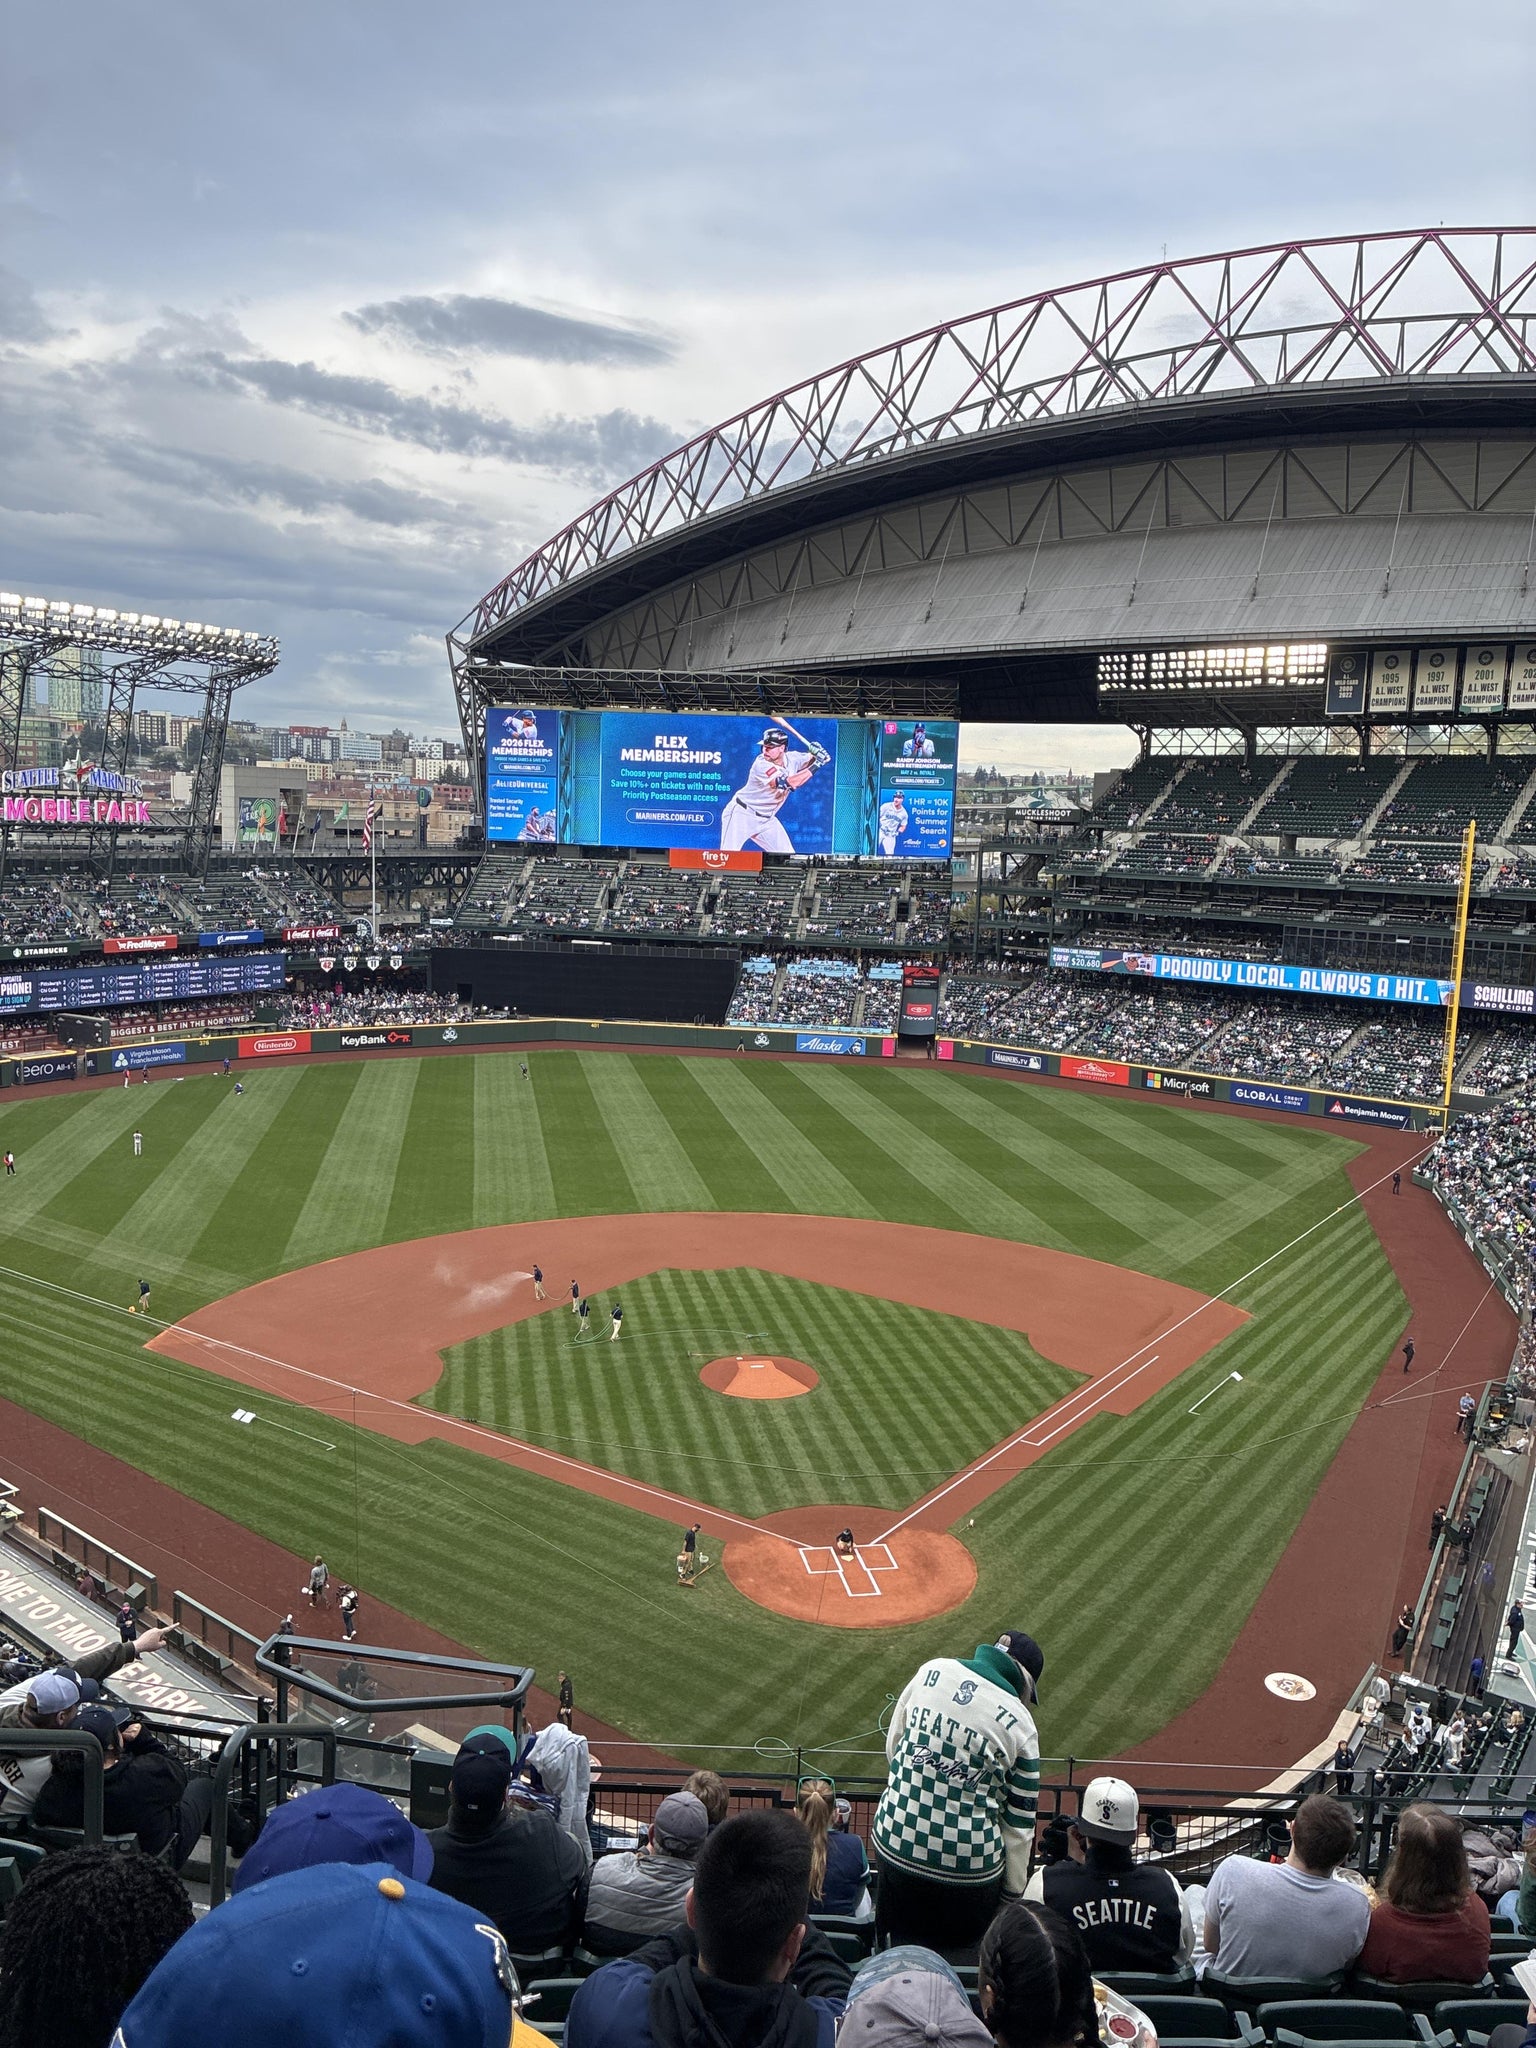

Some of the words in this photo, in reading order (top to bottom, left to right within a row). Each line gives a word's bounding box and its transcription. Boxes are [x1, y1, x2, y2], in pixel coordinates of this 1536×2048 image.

[1382, 673, 1400, 683] 1995
[1428, 672, 1444, 682] 1997
[1475, 670, 1494, 680] 2001
[1376, 687, 1386, 695] A.L.
[1387, 686, 1404, 694] WEST
[1420, 685, 1430, 694] A.L.
[1432, 684, 1449, 693] WEST
[1468, 684, 1480, 692] A.L.
[1480, 683, 1498, 692] WEST
[1372, 698, 1406, 706] CHAMPIONS
[1416, 696, 1452, 706] CHAMPIONS
[1464, 694, 1501, 704] CHAMPIONS
[501, 738, 523, 746] 2026
[524, 740, 544, 748] FLEX
[655, 735, 688, 748] FLEX
[492, 746, 553, 756] MEMBERSHIPS
[621, 748, 722, 764] MEMBERSHIPS
[620, 768, 646, 778] Choose
[647, 771, 662, 779] your
[664, 772, 686, 780] games
[688, 771, 701, 779] and
[702, 772, 722, 780] seats
[2, 767, 59, 792] SEATTLE
[88, 768, 144, 797] MARINERS
[610, 780, 628, 788] Save
[630, 780, 648, 788] 10%+
[661, 781, 686, 790] tickets
[687, 782, 702, 790] with
[715, 783, 730, 792] fees
[622, 790, 649, 800] Priority
[651, 792, 692, 800] Postseason
[693, 794, 718, 802] access
[914, 798, 926, 806] HR
[934, 798, 948, 806] 10K
[94, 800, 152, 822] PARK
[636, 812, 704, 822] MARINERS.COM/FLEX
[936, 808, 948, 816] for
[915, 817, 948, 826] Summer
[920, 826, 946, 834] Search
[702, 851, 718, 860] fire
[720, 853, 730, 861] tv
[24, 947, 68, 956] STARBUCKS
[1162, 958, 1232, 982] PROUDLY
[1236, 964, 1294, 988] LOCAL.
[1300, 970, 1371, 996] ALWAYS
[1377, 978, 1389, 997] A
[1395, 979, 1430, 1002] HIT.
[1, 982, 32, 996] PHONE!
[12, 996, 24, 1004] SIGN
[24, 995, 31, 1003] UP
[1474, 986, 1534, 1006] SCHILLING
[1506, 1004, 1532, 1012] CIDER
[110, 1026, 147, 1037] BIGGEST
[158, 1022, 178, 1031] BEST
[190, 1020, 206, 1028] THE
[258, 1040, 292, 1050] Nintendo
[342, 1035, 387, 1046] KeyBank
[800, 1037, 843, 1052] Alaska
[130, 1050, 152, 1058] Virginia
[130, 1056, 160, 1064] Franciscan
[161, 1052, 182, 1060] Health
[1236, 1088, 1282, 1103] GLOBAL
[1344, 1106, 1379, 1118] Benjamin
[1380, 1110, 1404, 1122] Moore
[19, 1594, 60, 1620] TO
[924, 1670, 940, 1687] 19
[952, 1680, 978, 1706] S
[994, 1705, 1018, 1730] 77
[910, 1706, 1006, 1766] SEATTLE
[912, 1744, 988, 1788] Baseball
[1096, 1800, 1120, 1814] SEATTLE
[1102, 1806, 1111, 1820] S
[1072, 1898, 1158, 1930] SEATTLE
